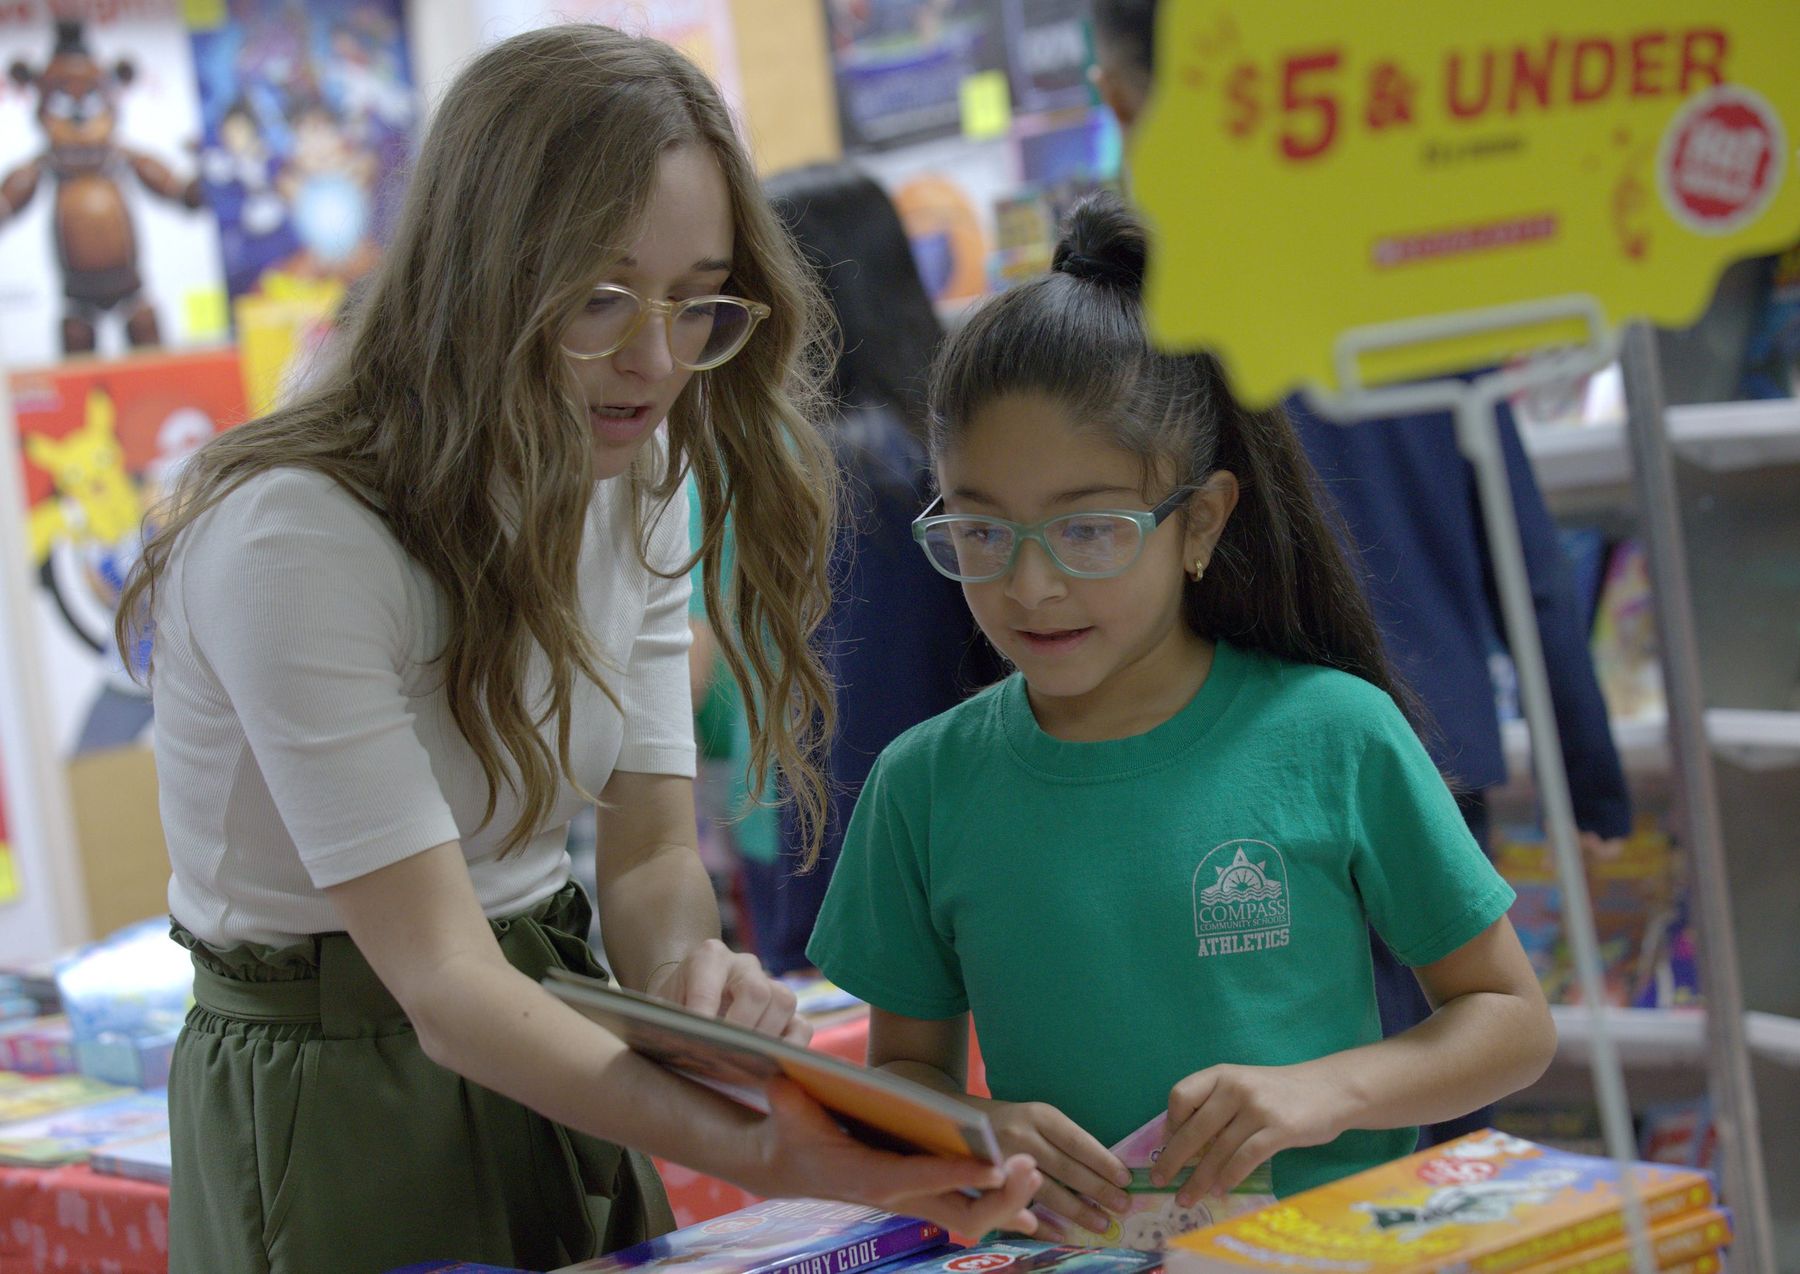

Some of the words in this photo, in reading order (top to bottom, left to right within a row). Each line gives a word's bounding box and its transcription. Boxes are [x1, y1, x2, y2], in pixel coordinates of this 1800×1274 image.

[1225, 48, 1342, 161] $5
[1365, 60, 1416, 129] &
[1444, 28, 1731, 122] UNDER
[1199, 899, 1286, 923] COMPASS
[1200, 920, 1252, 932] COMMUNITY
[1252, 915, 1286, 927] SCHOOLS
[1198, 929, 1289, 957] ATHLETICS
[837, 1238, 881, 1272] CODE
